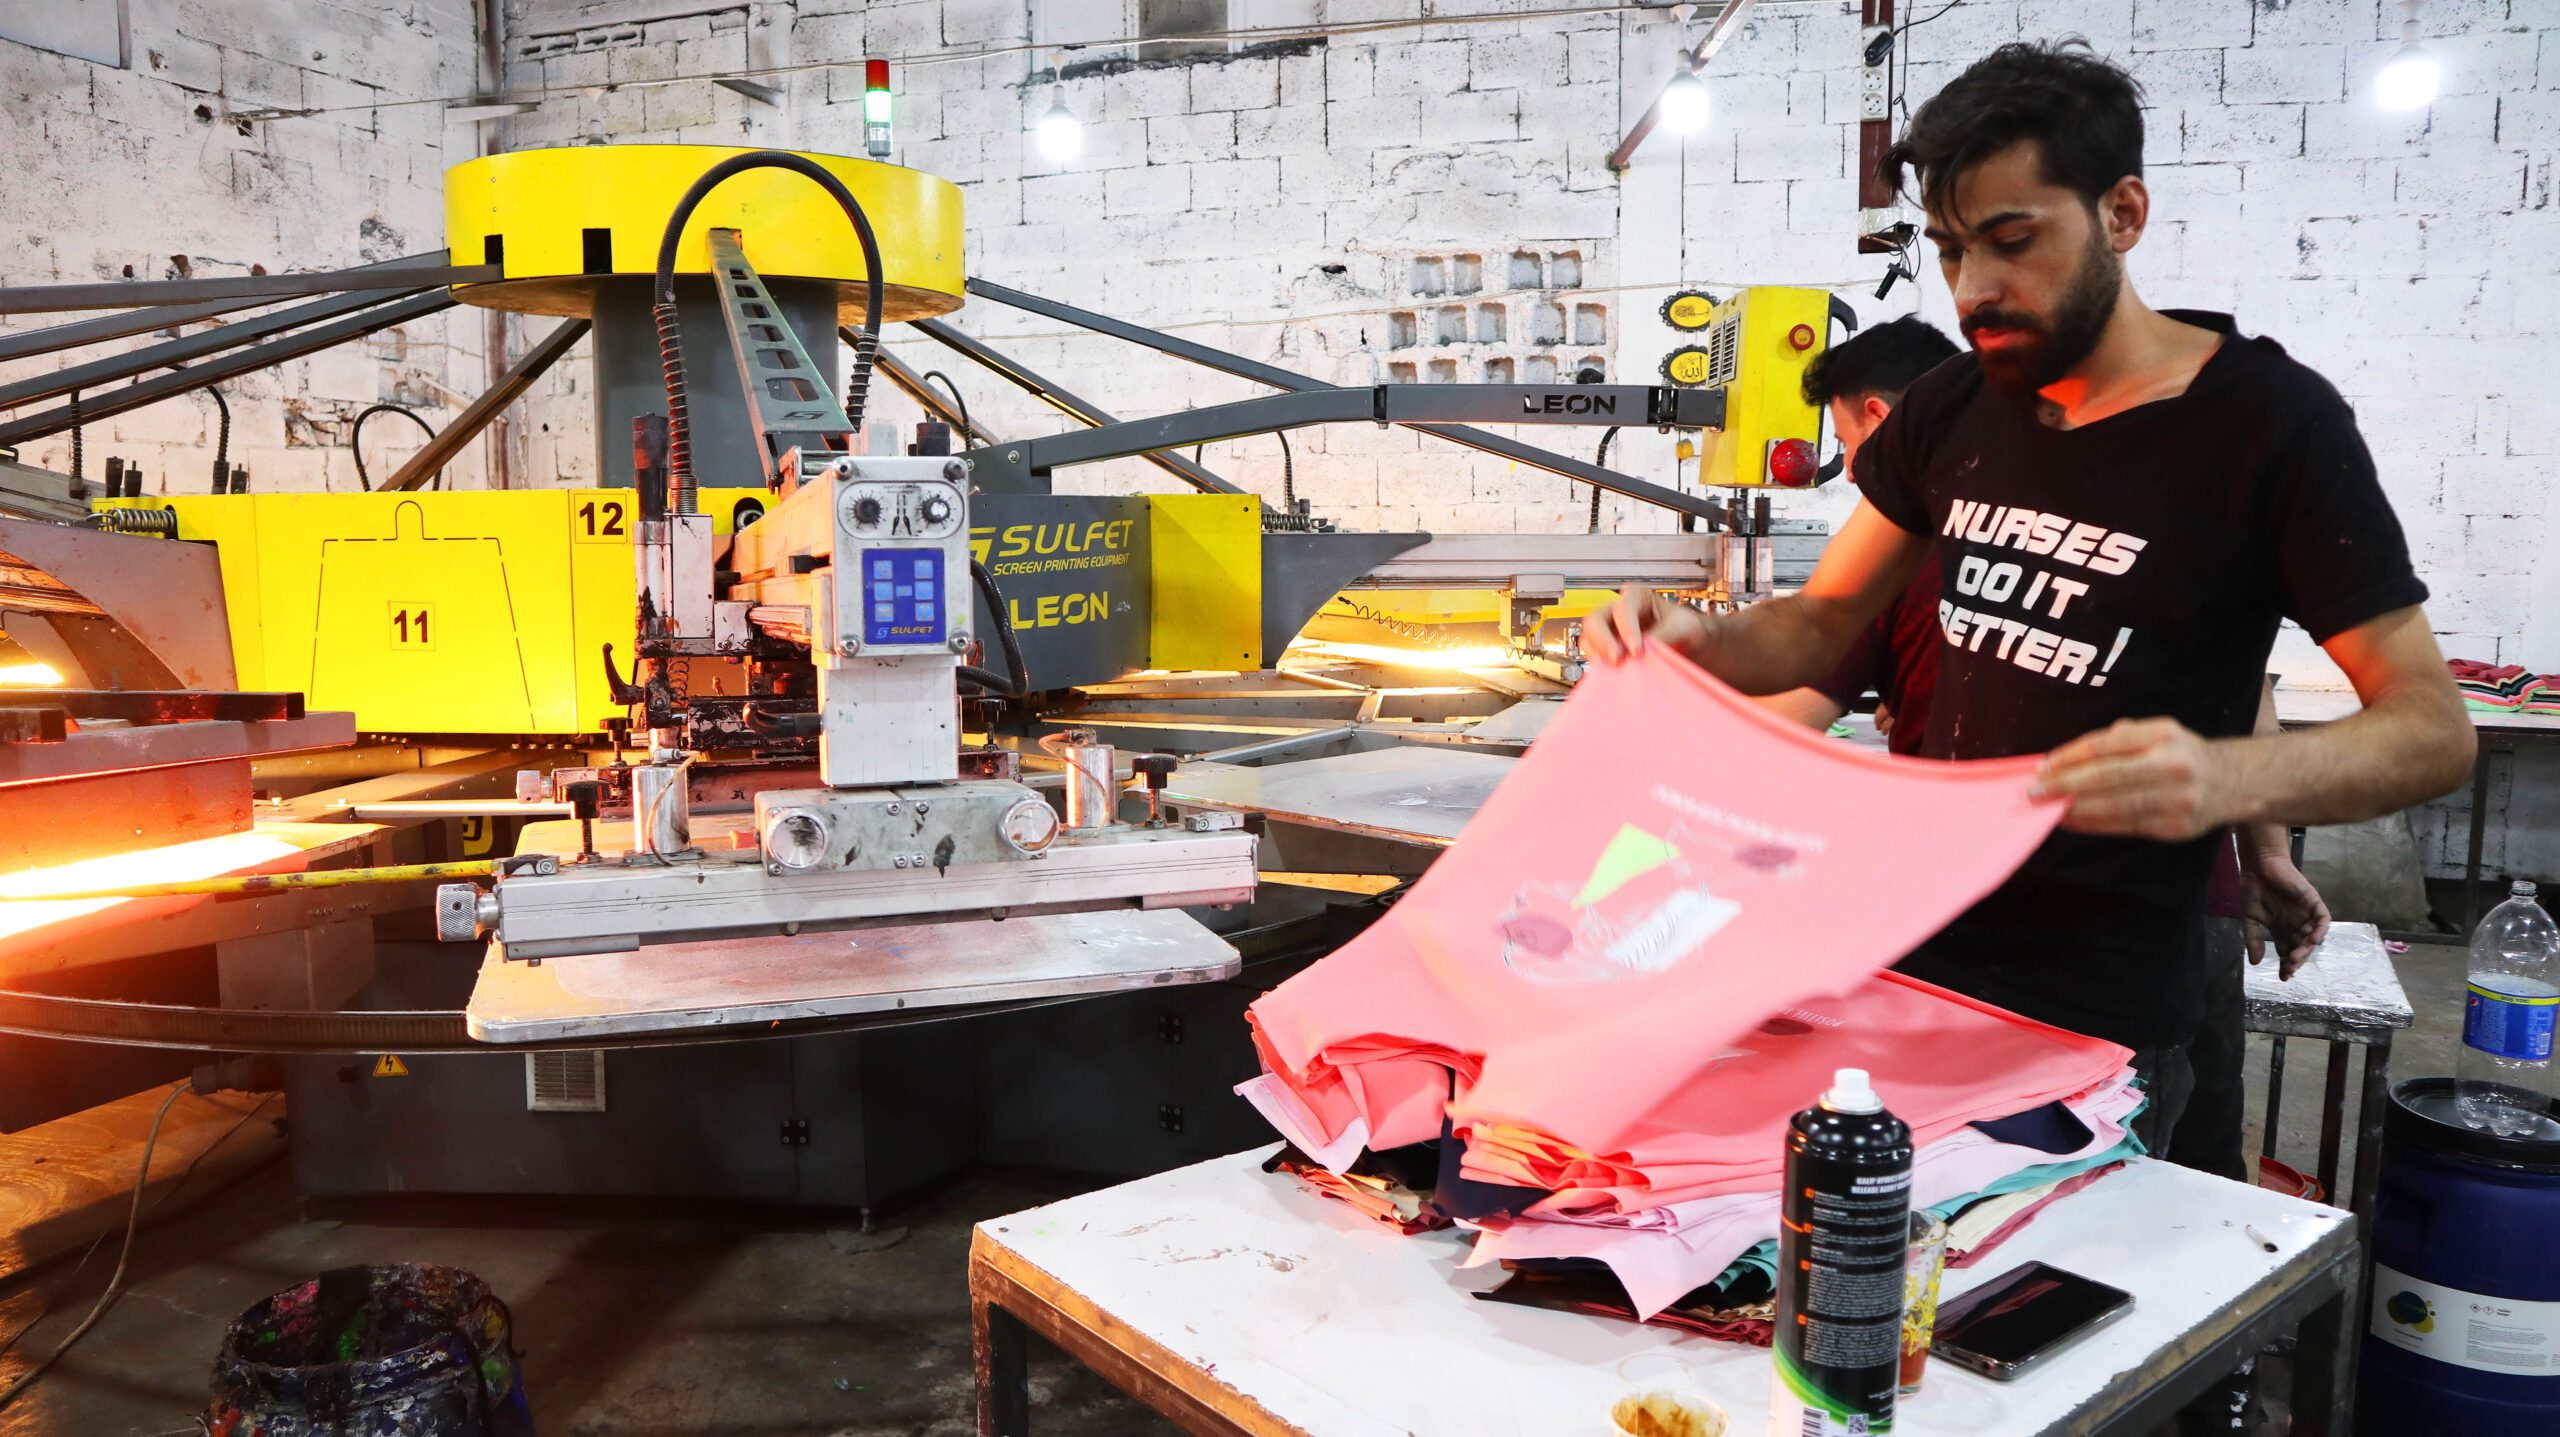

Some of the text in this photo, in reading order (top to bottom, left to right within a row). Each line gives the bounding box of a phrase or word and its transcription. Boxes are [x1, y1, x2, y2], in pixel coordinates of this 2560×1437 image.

[1523, 394, 1617, 415] LEON
[579, 502, 624, 535] 12
[998, 519, 1134, 557] SULFET
[1941, 498, 2149, 576] NURSES
[993, 552, 1130, 576] SCREEN PRINTING EQUIPMENT
[1956, 555, 2090, 619] DO IT
[394, 610, 428, 643] 11
[1010, 591, 1108, 630] LEON
[890, 626, 935, 635] SULFET
[1938, 598, 2133, 687] BETTER!
